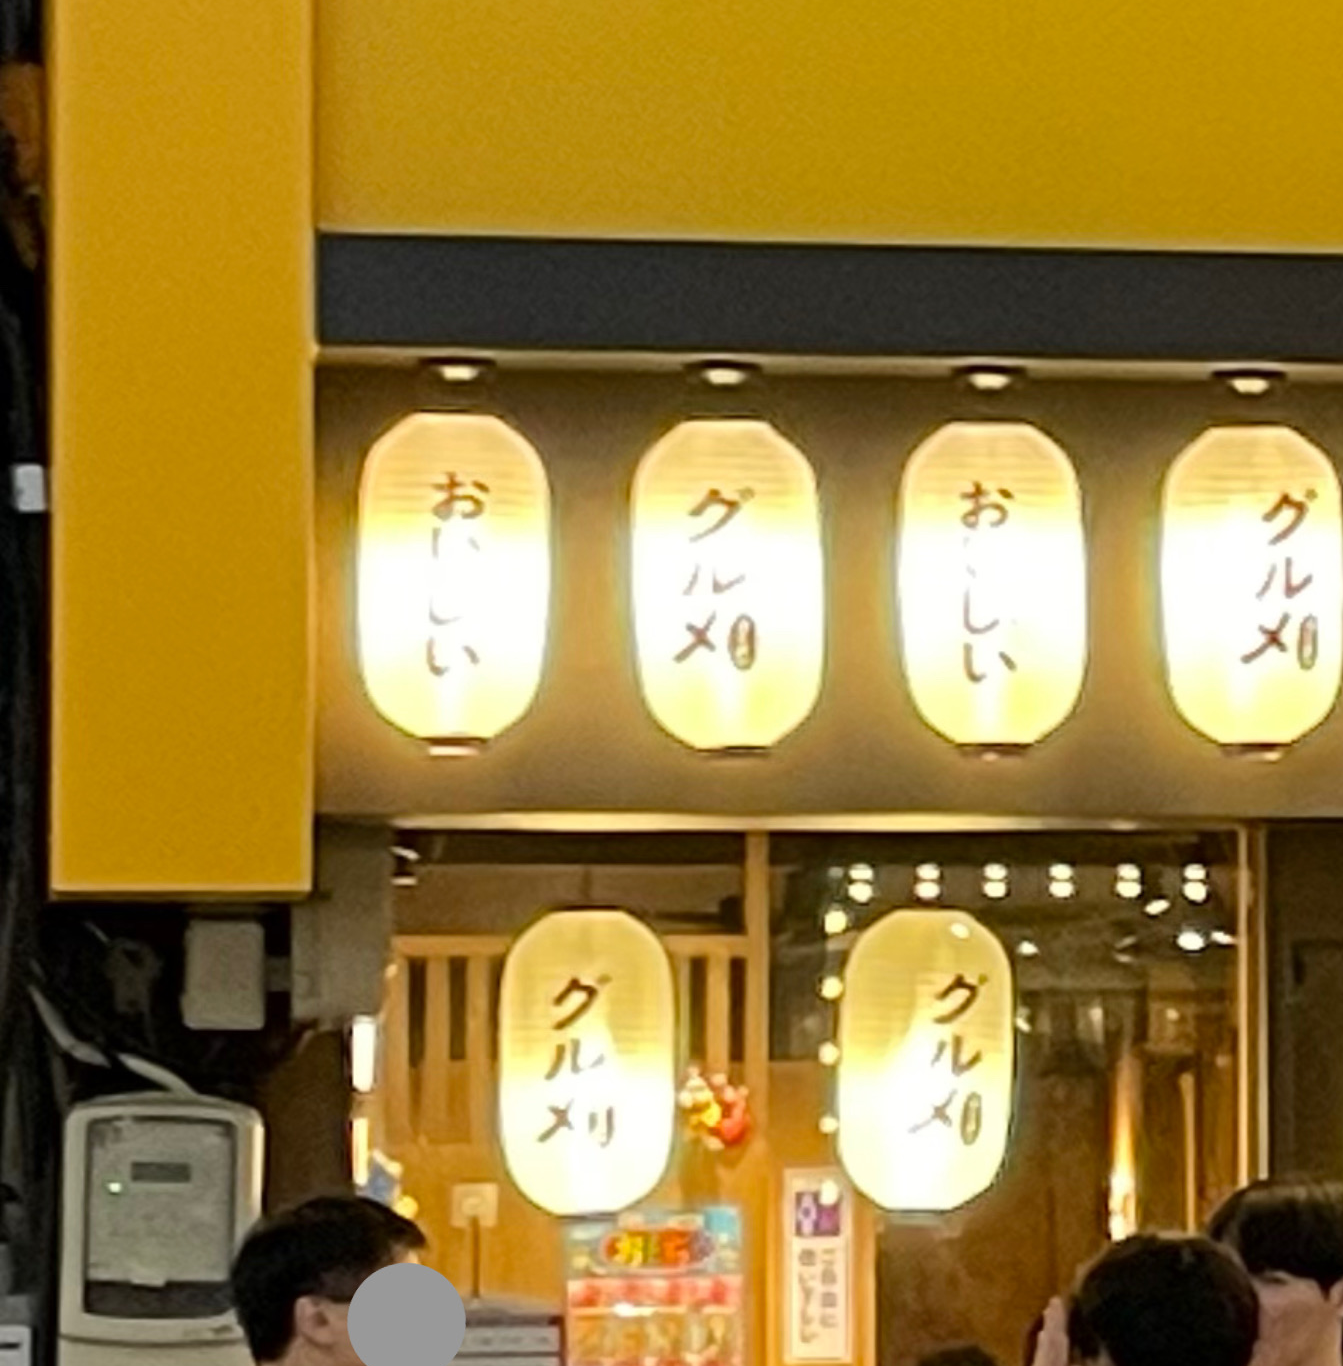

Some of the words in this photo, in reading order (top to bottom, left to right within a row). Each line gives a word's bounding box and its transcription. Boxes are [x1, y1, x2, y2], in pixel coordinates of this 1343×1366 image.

[674, 487, 755, 664] グルメ
[1241, 488, 1319, 665] グルメ
[536, 974, 612, 1143] グルメ
[907, 973, 989, 1134] グルメ
